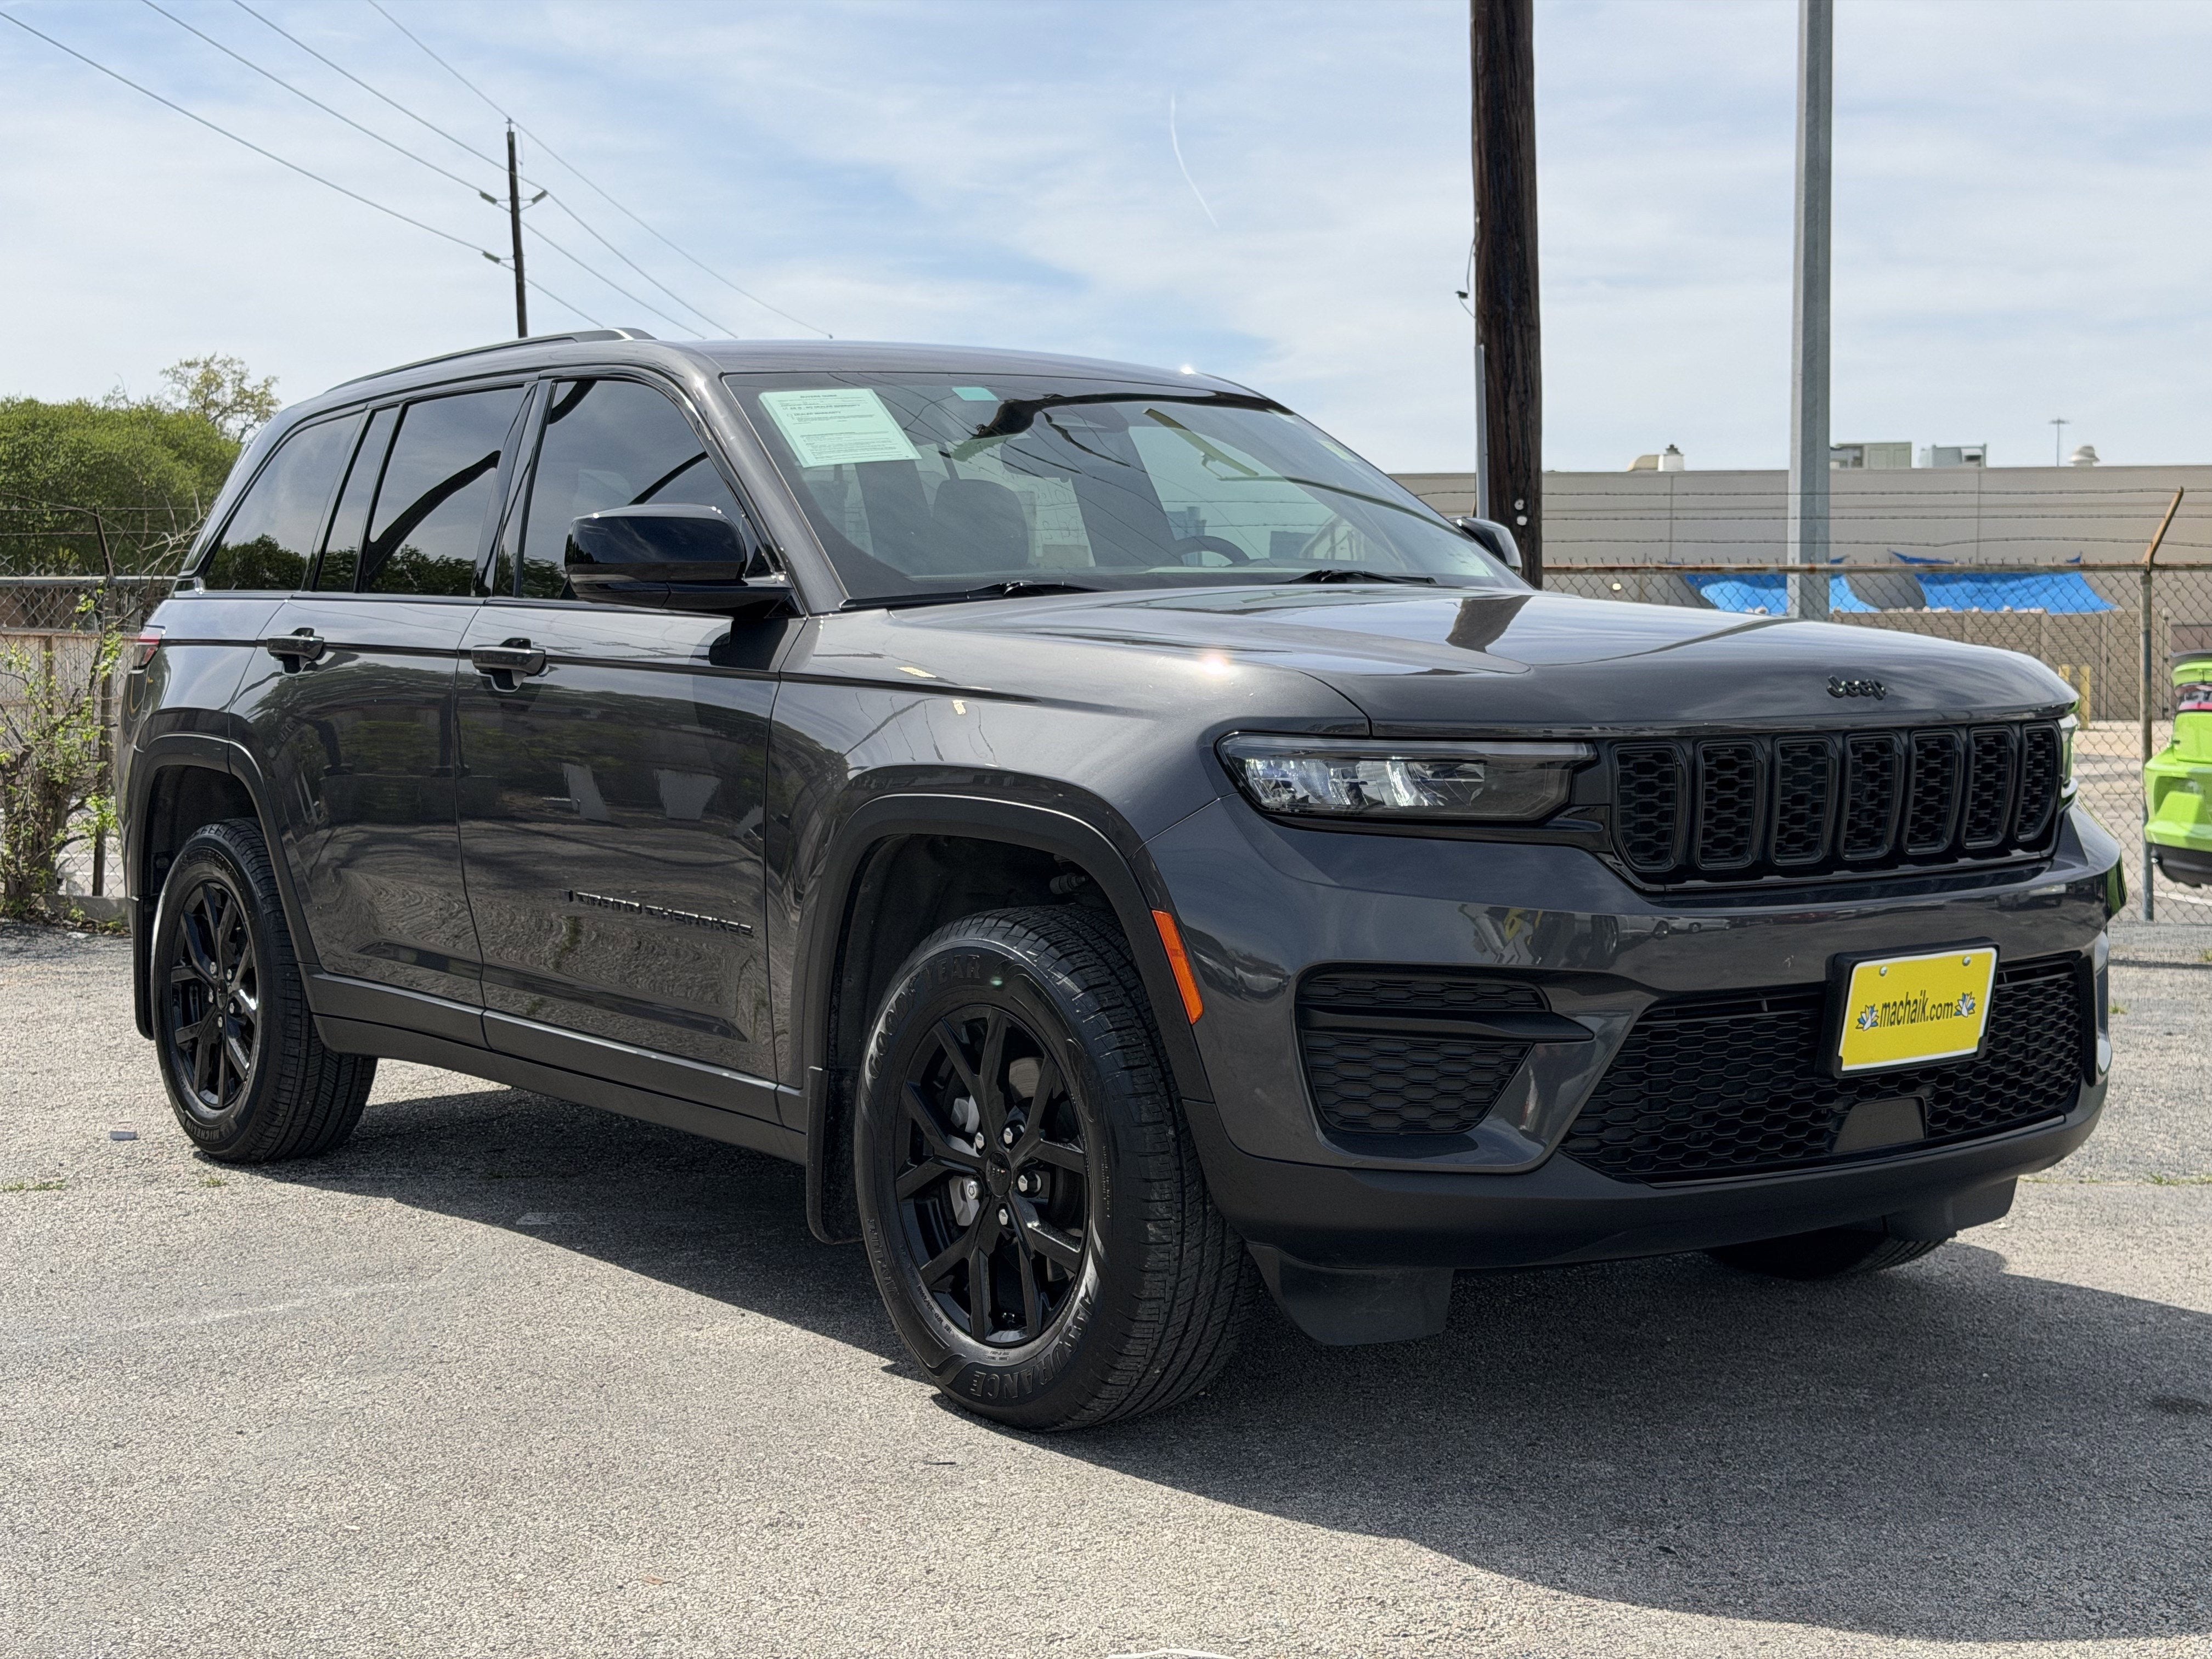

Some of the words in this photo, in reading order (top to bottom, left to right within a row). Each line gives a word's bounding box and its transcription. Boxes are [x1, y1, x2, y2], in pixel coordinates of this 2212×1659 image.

[1826, 675, 1887, 701] Jeep
[868, 954, 981, 1079] GOODYEAR
[1880, 990, 1953, 1028] machaik.com
[970, 1282, 1094, 1399] ASSURANCE
